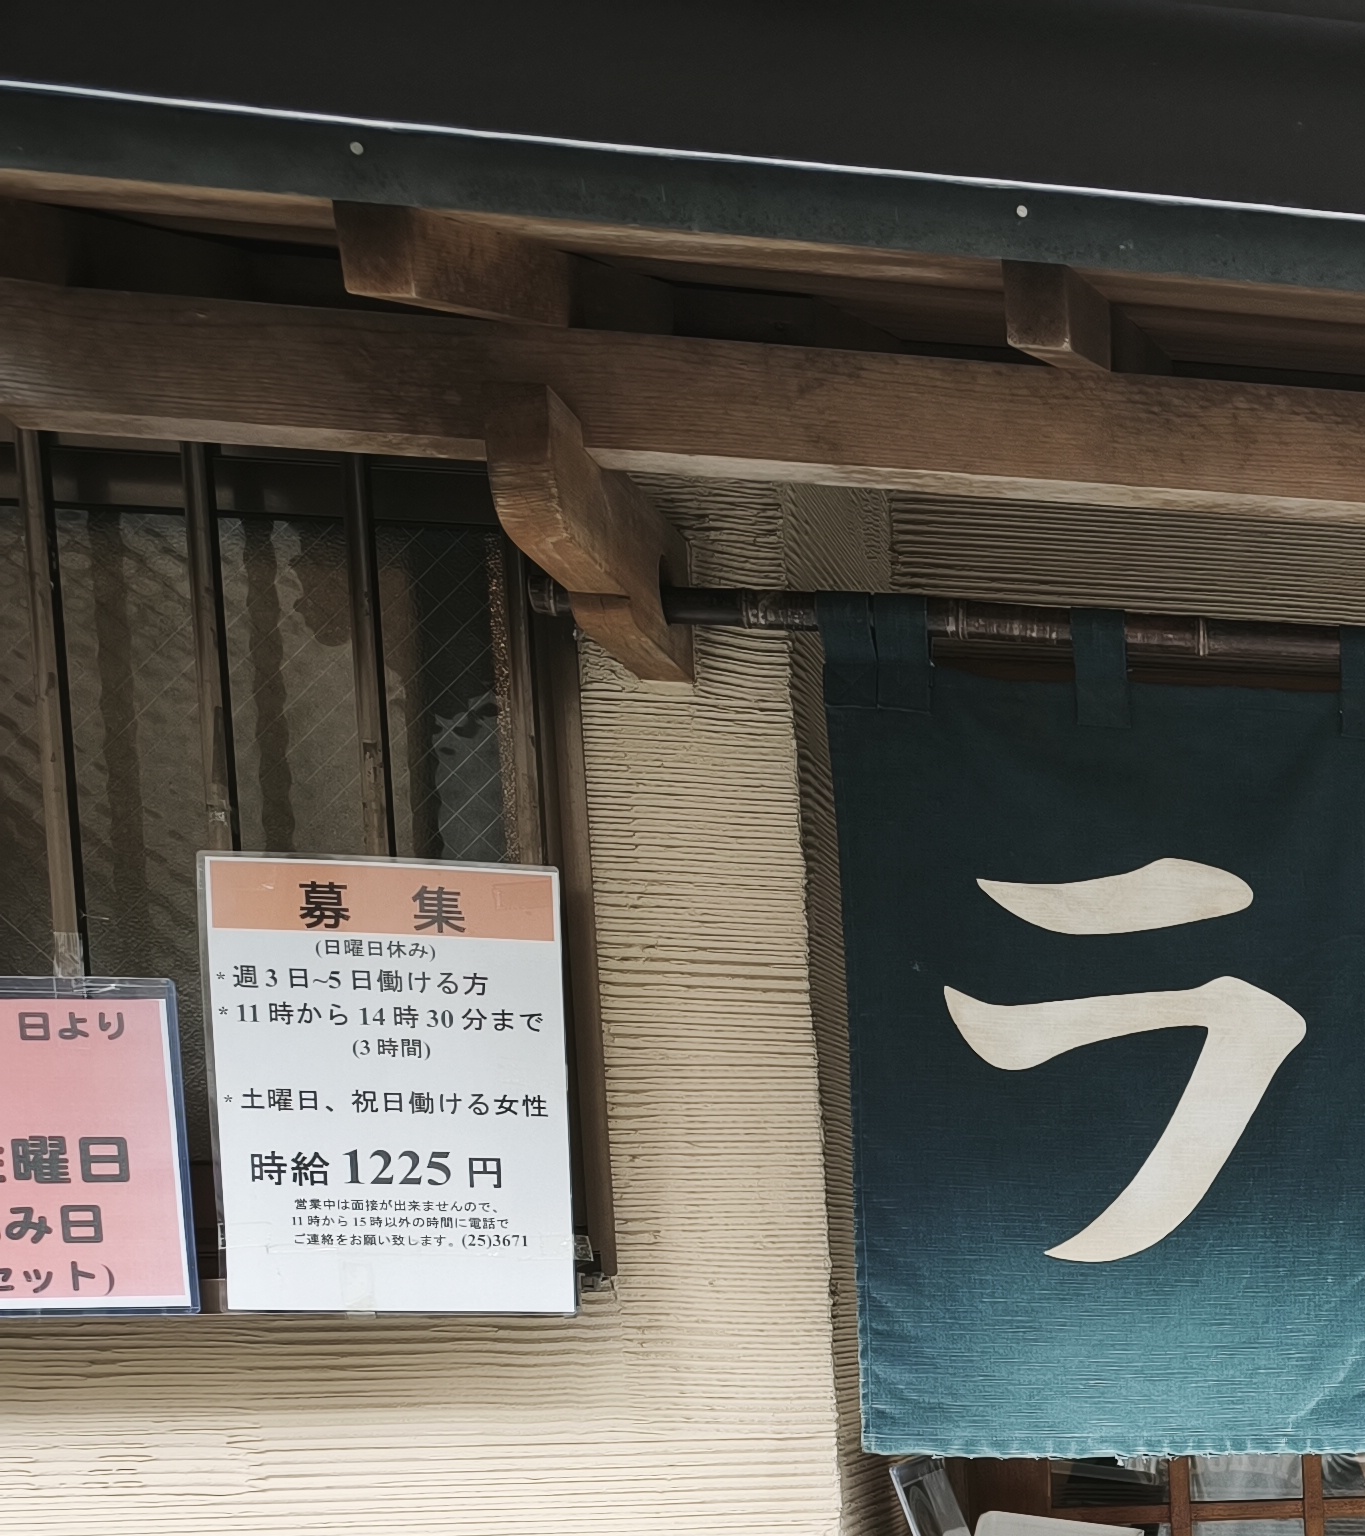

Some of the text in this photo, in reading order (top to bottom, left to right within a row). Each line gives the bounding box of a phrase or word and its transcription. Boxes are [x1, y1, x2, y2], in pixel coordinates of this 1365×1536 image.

[315, 939, 436, 962] (日曜日休み)
[18, 1011, 125, 1040] 日より
[352, 1038, 431, 1060] (3時間)
[0, 1135, 130, 1183] 曜日
[0, 1205, 103, 1244] み日
